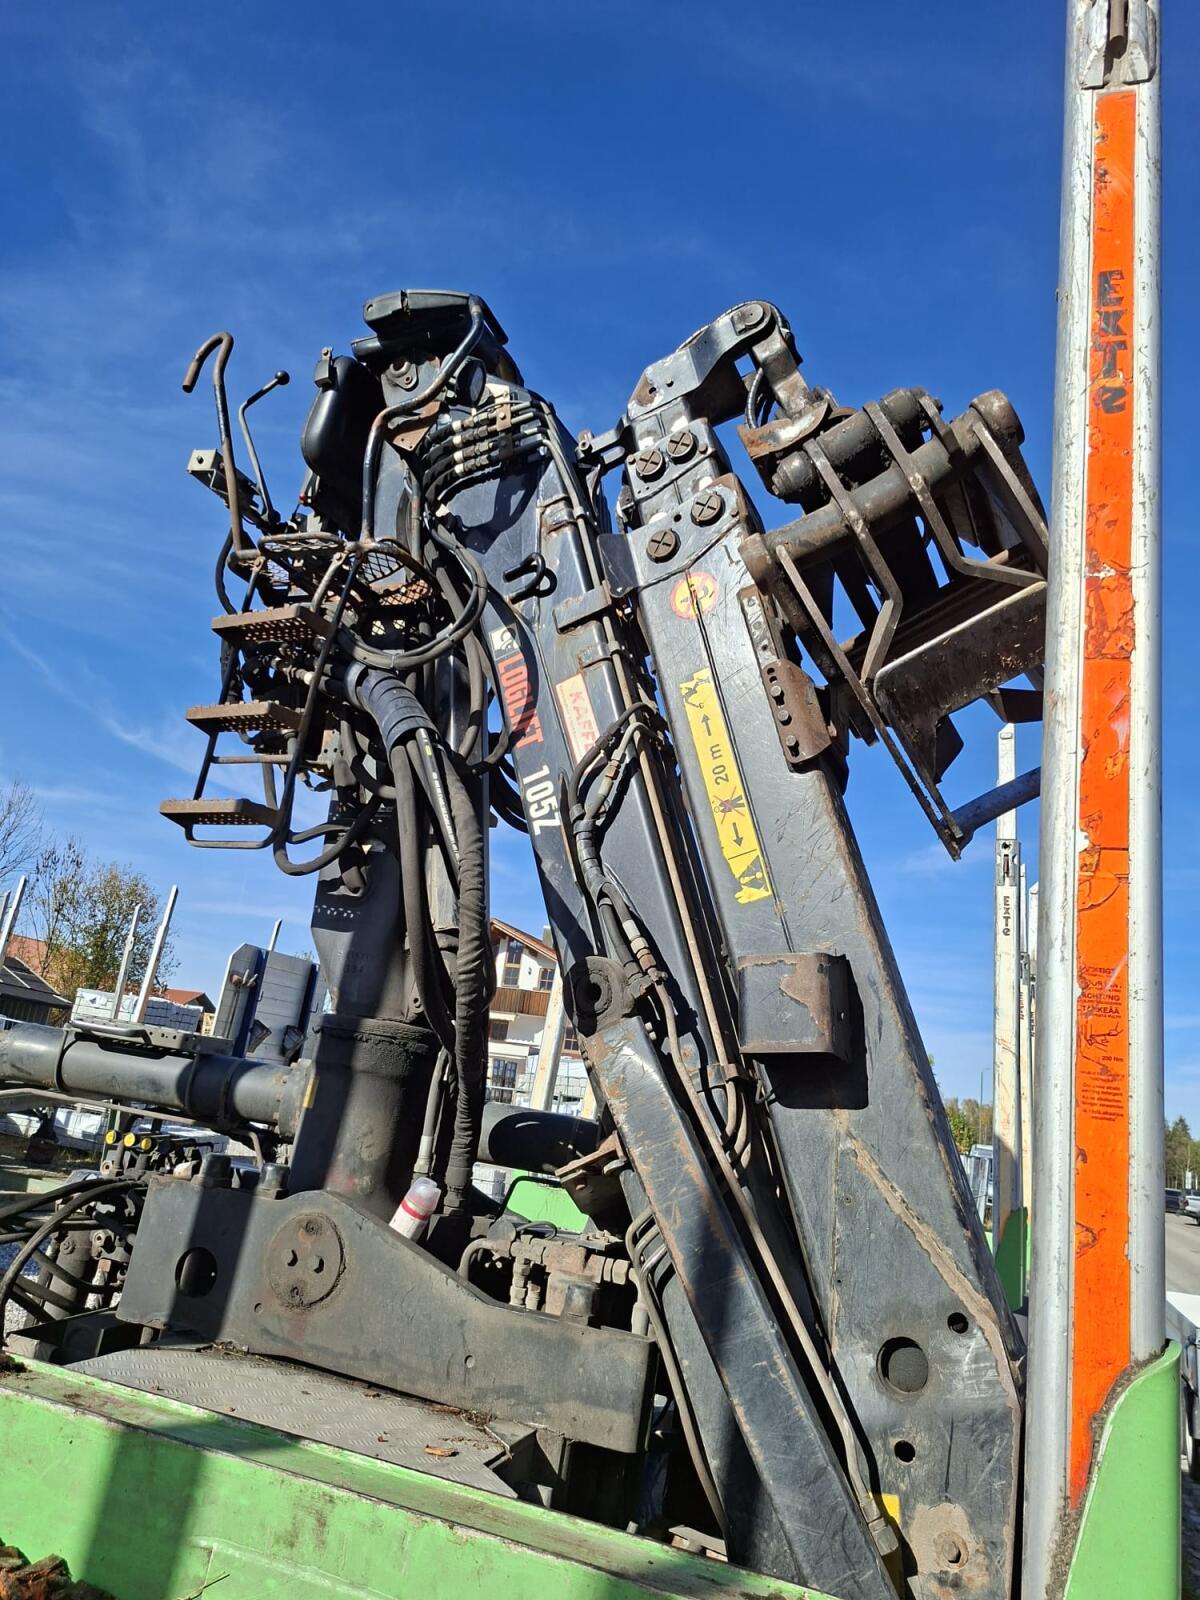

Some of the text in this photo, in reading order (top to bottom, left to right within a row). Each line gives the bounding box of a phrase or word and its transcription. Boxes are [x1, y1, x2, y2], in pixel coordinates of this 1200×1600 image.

[497, 652, 544, 749] LOGLIFT
[522, 764, 561, 836] 105Z
[710, 743, 729, 786] 20 m
